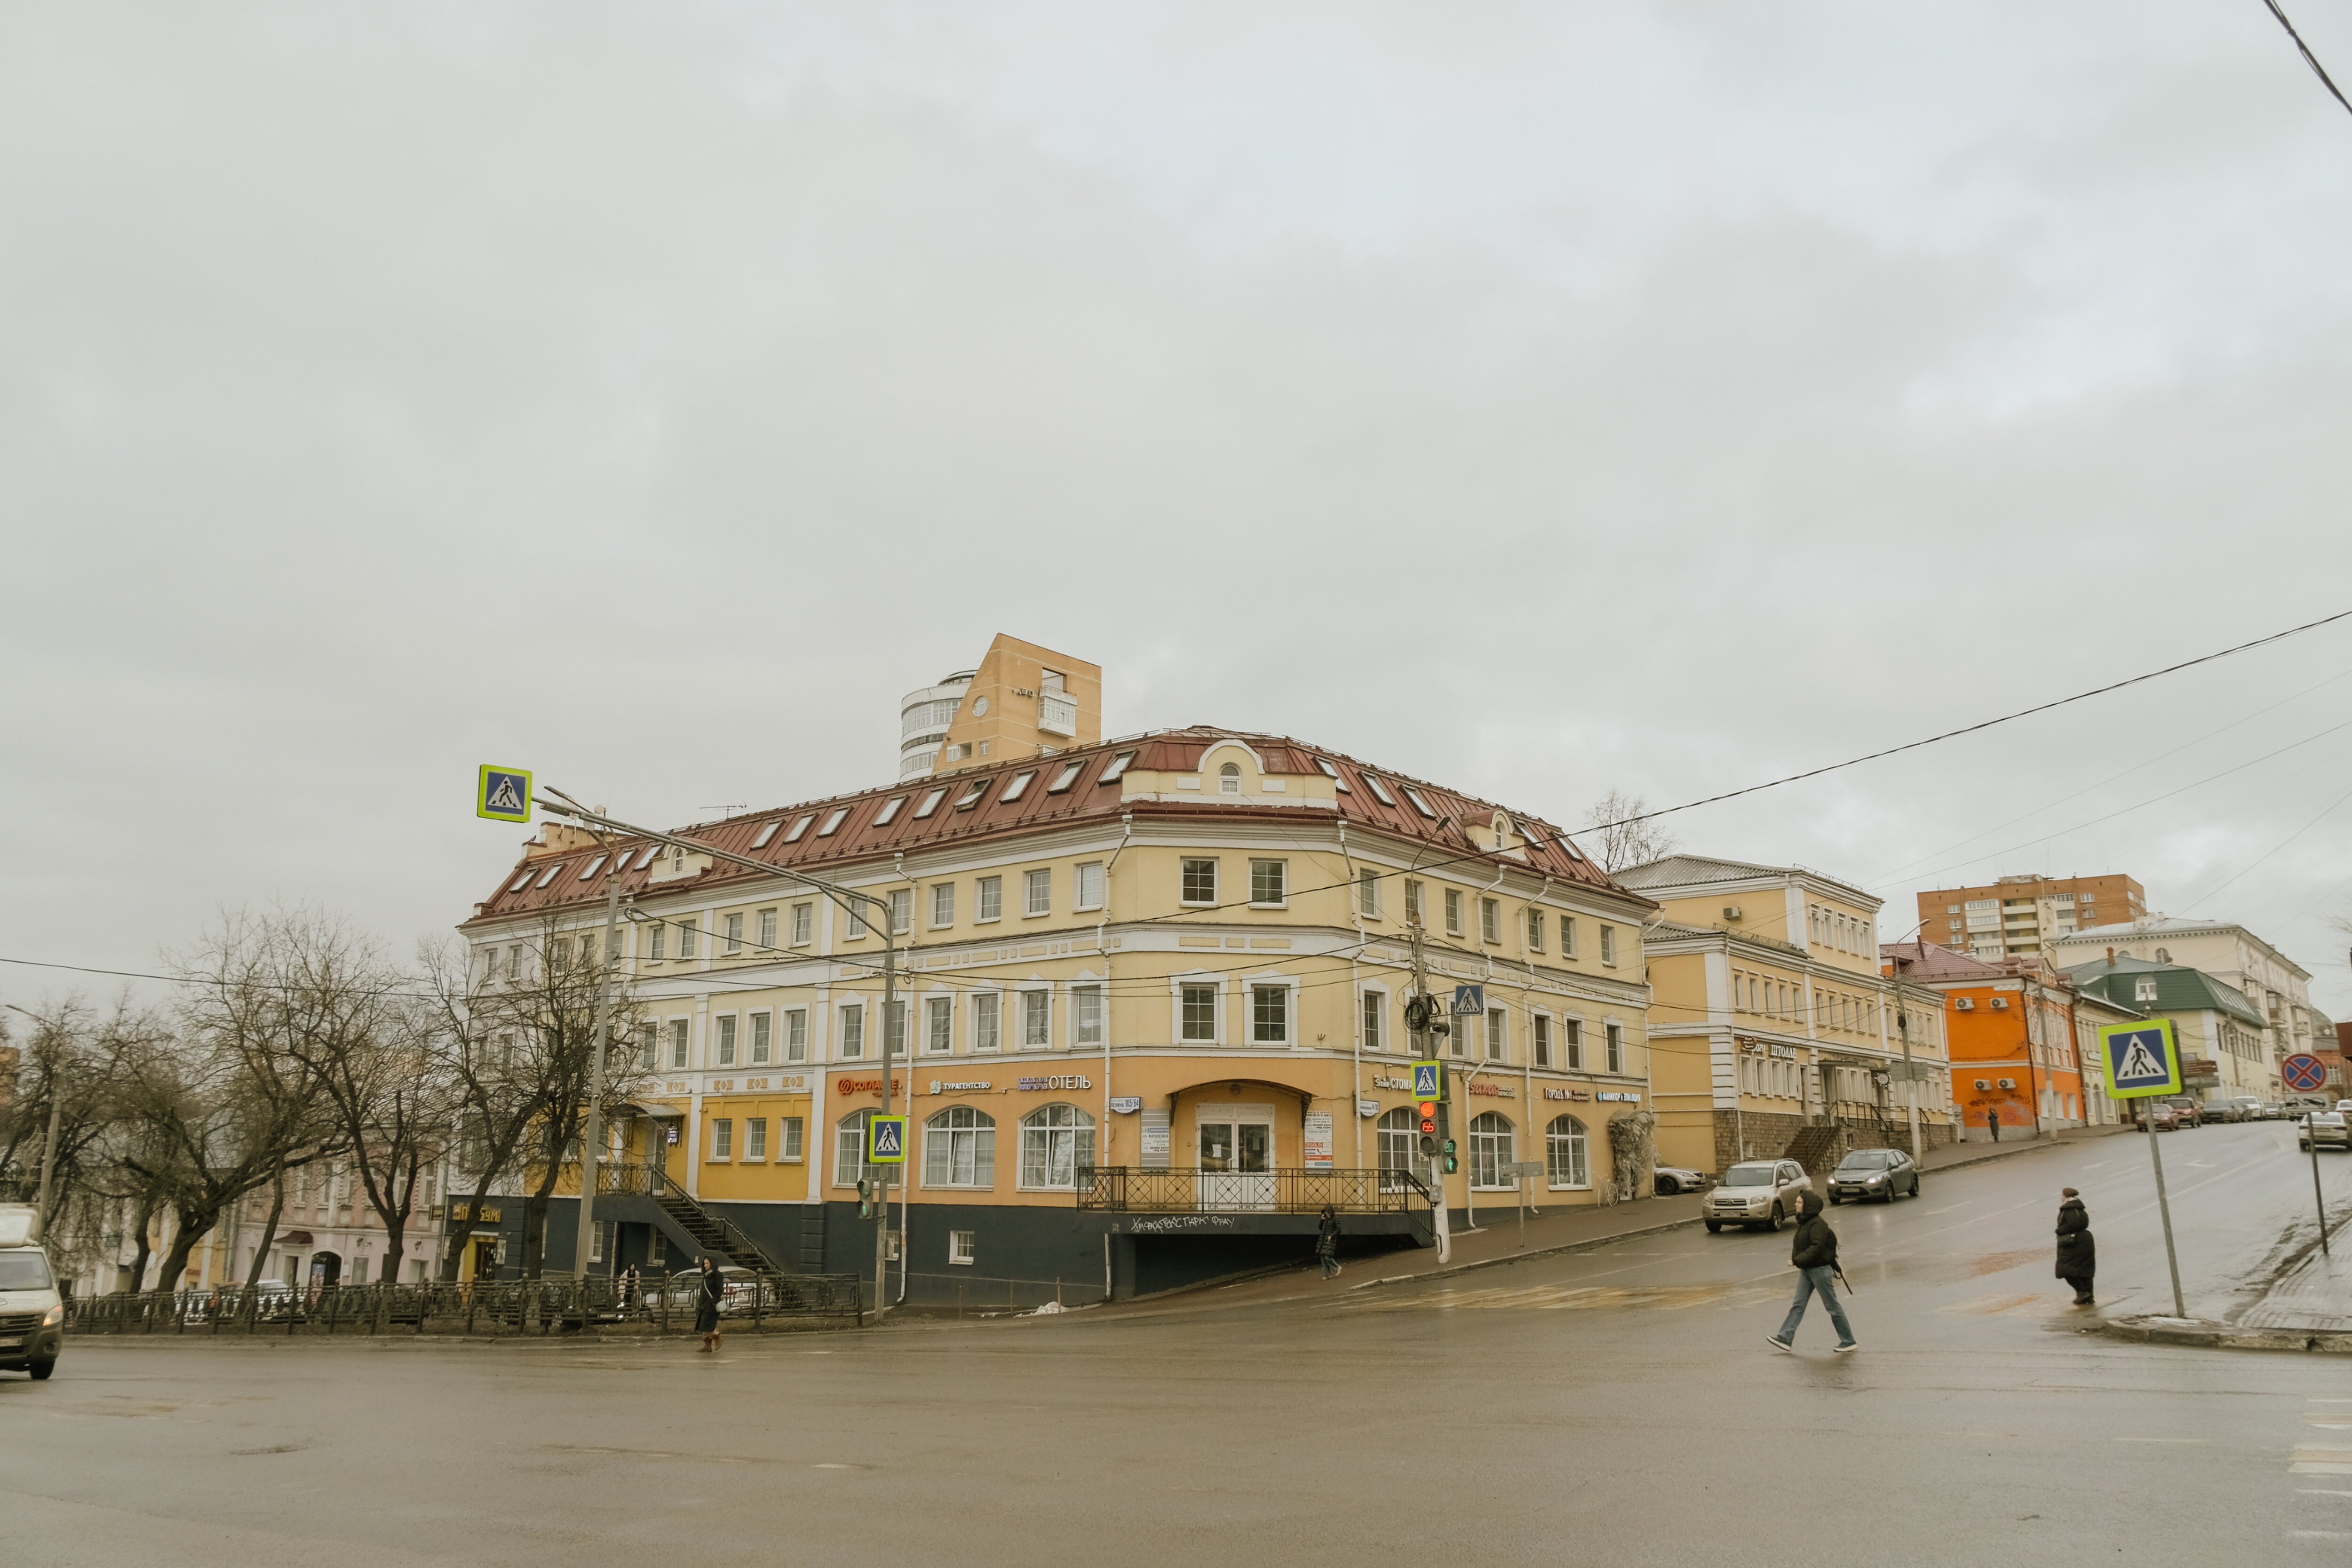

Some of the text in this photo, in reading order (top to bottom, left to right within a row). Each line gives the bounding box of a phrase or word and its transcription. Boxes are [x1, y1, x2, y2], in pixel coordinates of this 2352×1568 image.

[1771, 1044, 1796, 1059] ШТОЛЛЕ
[853, 1079, 898, 1090] СОГЛАЕ
[1049, 1075, 1091, 1089] ОТЕЛЬ
[1125, 1098, 1139, 1108] 105/64
